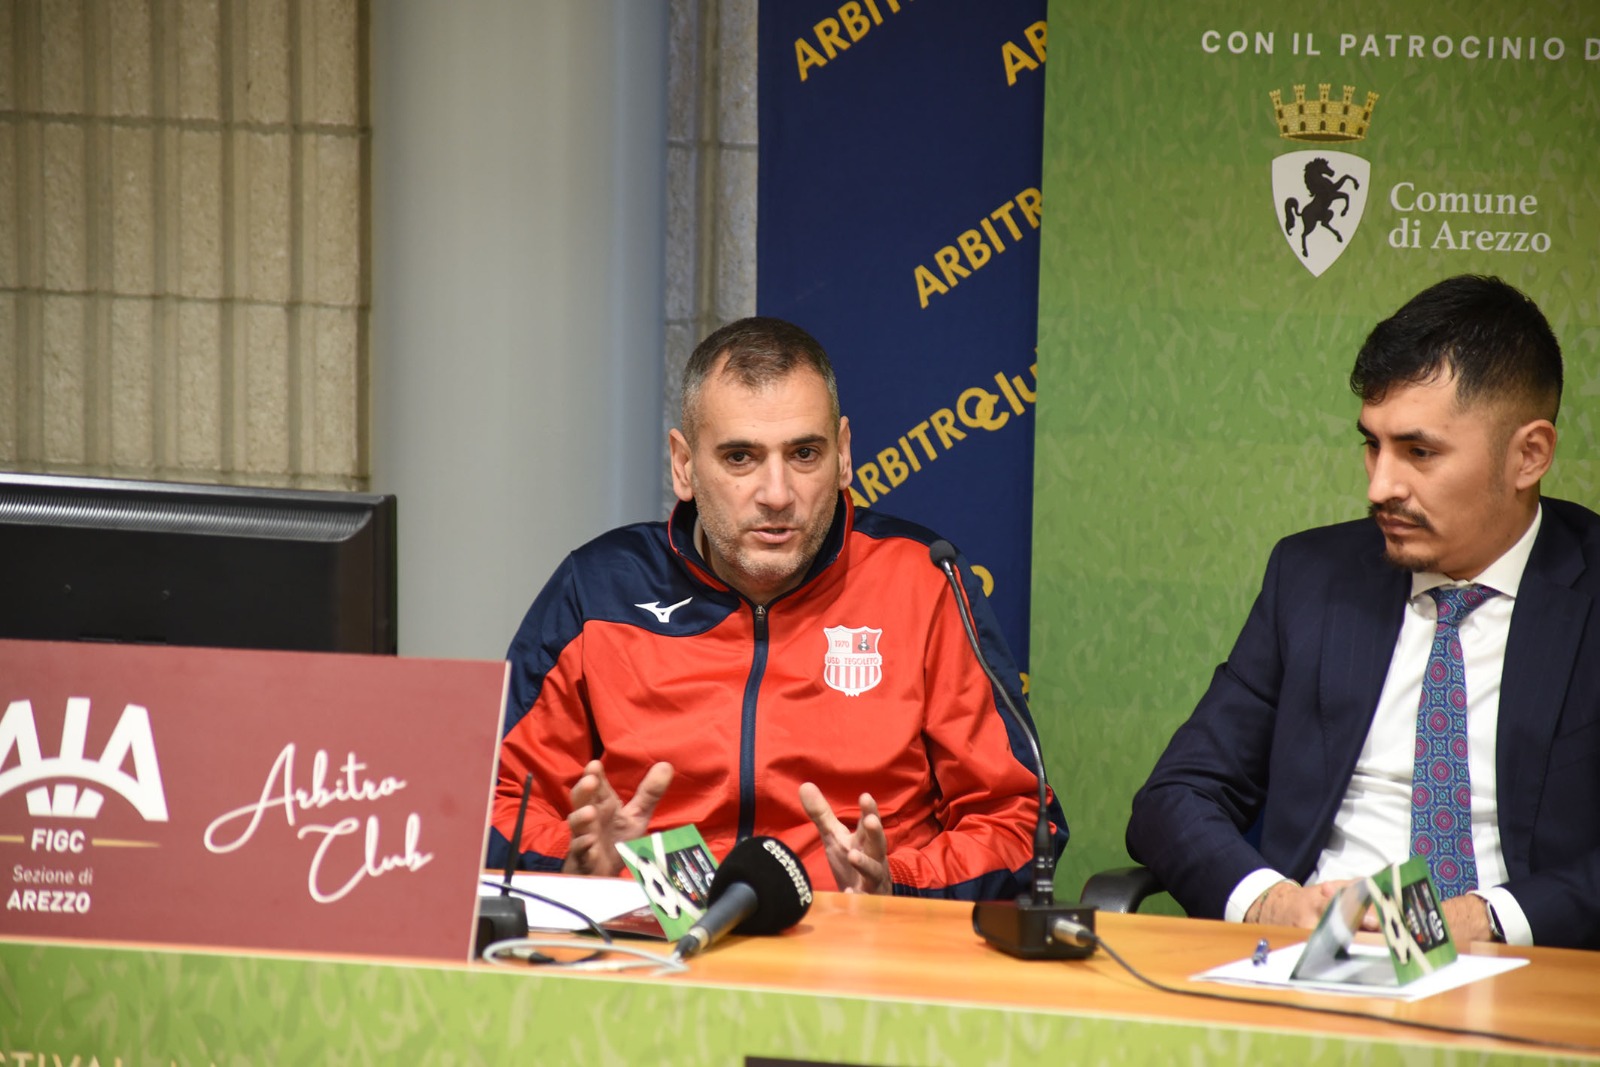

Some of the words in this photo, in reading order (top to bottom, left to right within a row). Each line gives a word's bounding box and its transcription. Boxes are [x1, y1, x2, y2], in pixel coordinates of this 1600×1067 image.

[1201, 30, 1275, 55] CON
[1293, 33, 1321, 55] IL
[1340, 34, 1565, 60] PATROCINIO
[1390, 182, 1538, 215] Comune
[914, 187, 1042, 309] ARBITR
[1388, 218, 1421, 248] di
[1431, 221, 1552, 253] Arezzo
[835, 640, 850, 648] 1970
[827, 656, 840, 664] USD
[204, 743, 407, 853] Arbitro
[31, 828, 85, 853] FIGC
[298, 813, 435, 903] Club
[13, 864, 74, 884] Sezione
[78, 867, 93, 886] di
[6, 889, 91, 914] AREZZO
